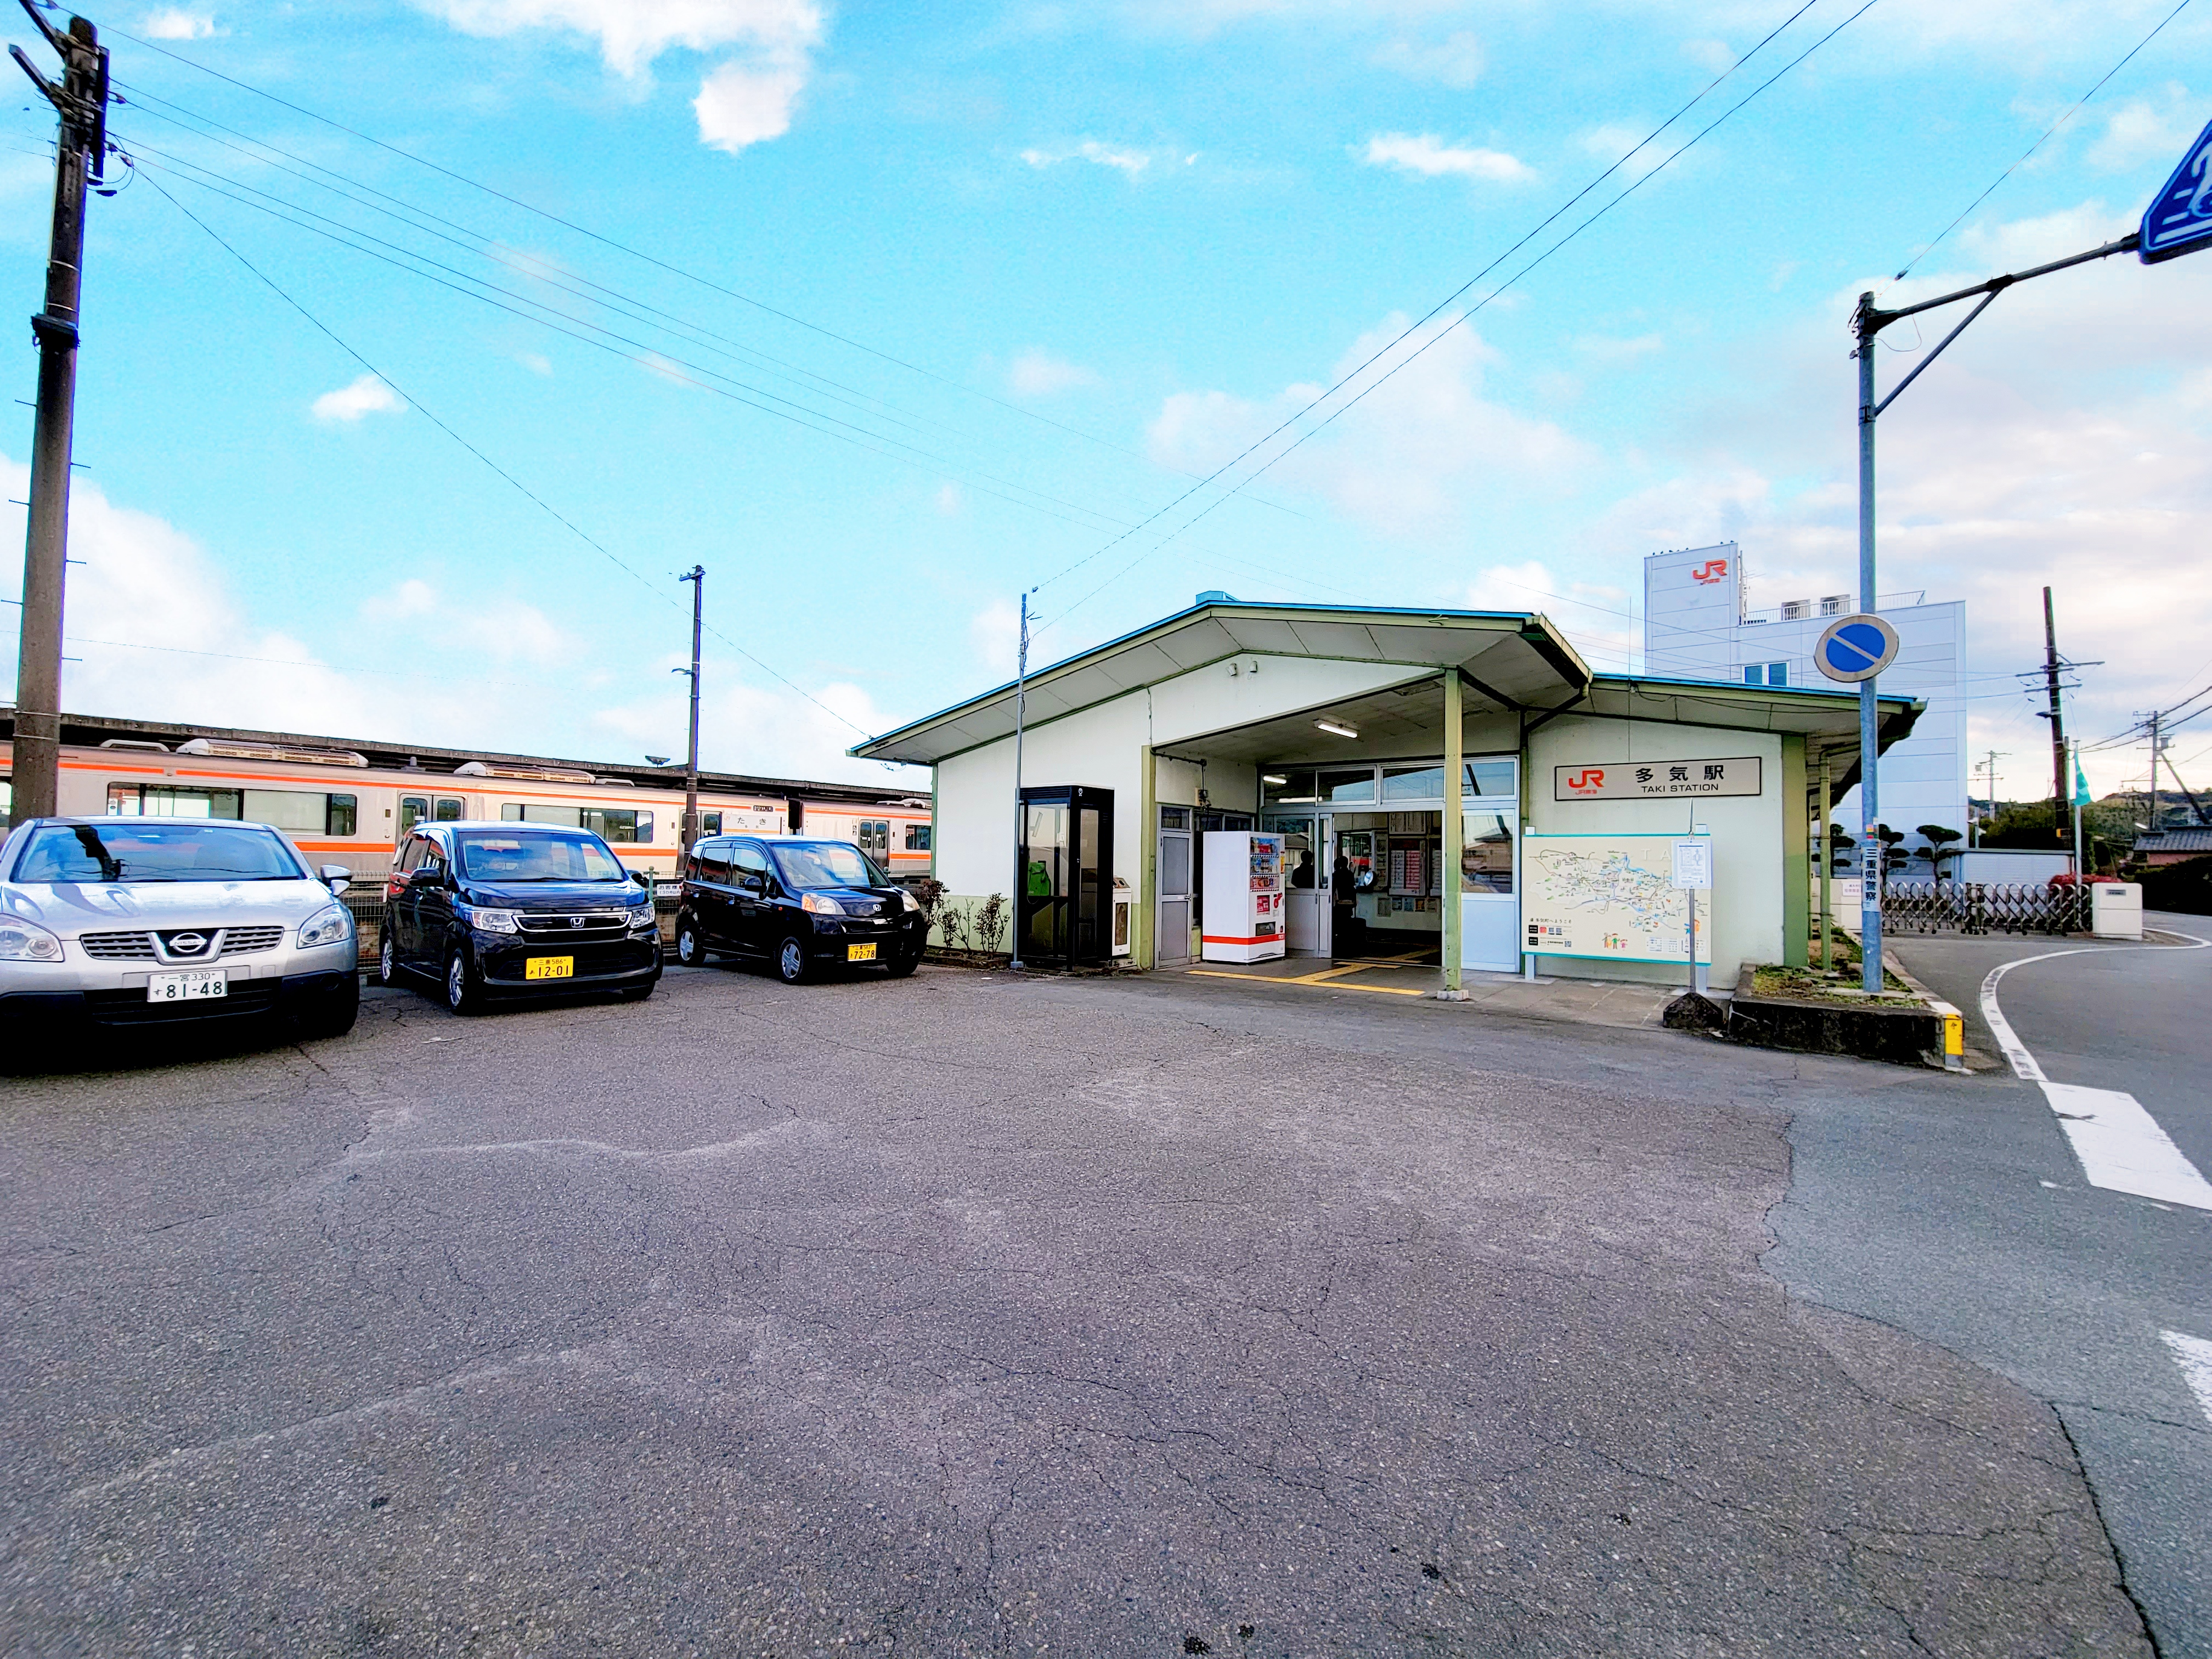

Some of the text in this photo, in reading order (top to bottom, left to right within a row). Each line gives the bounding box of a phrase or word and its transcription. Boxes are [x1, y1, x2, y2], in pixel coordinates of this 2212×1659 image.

[1693, 560, 1727, 579] JR
[1568, 769, 1604, 788] JR
[1635, 765, 1724, 783] 多気駅
[1670, 783, 1719, 792] STATION
[1865, 849, 1877, 901] 三重県警察
[854, 950, 875, 959] 72-78
[539, 965, 568, 977] 12-01
[166, 981, 222, 998] 81-48
